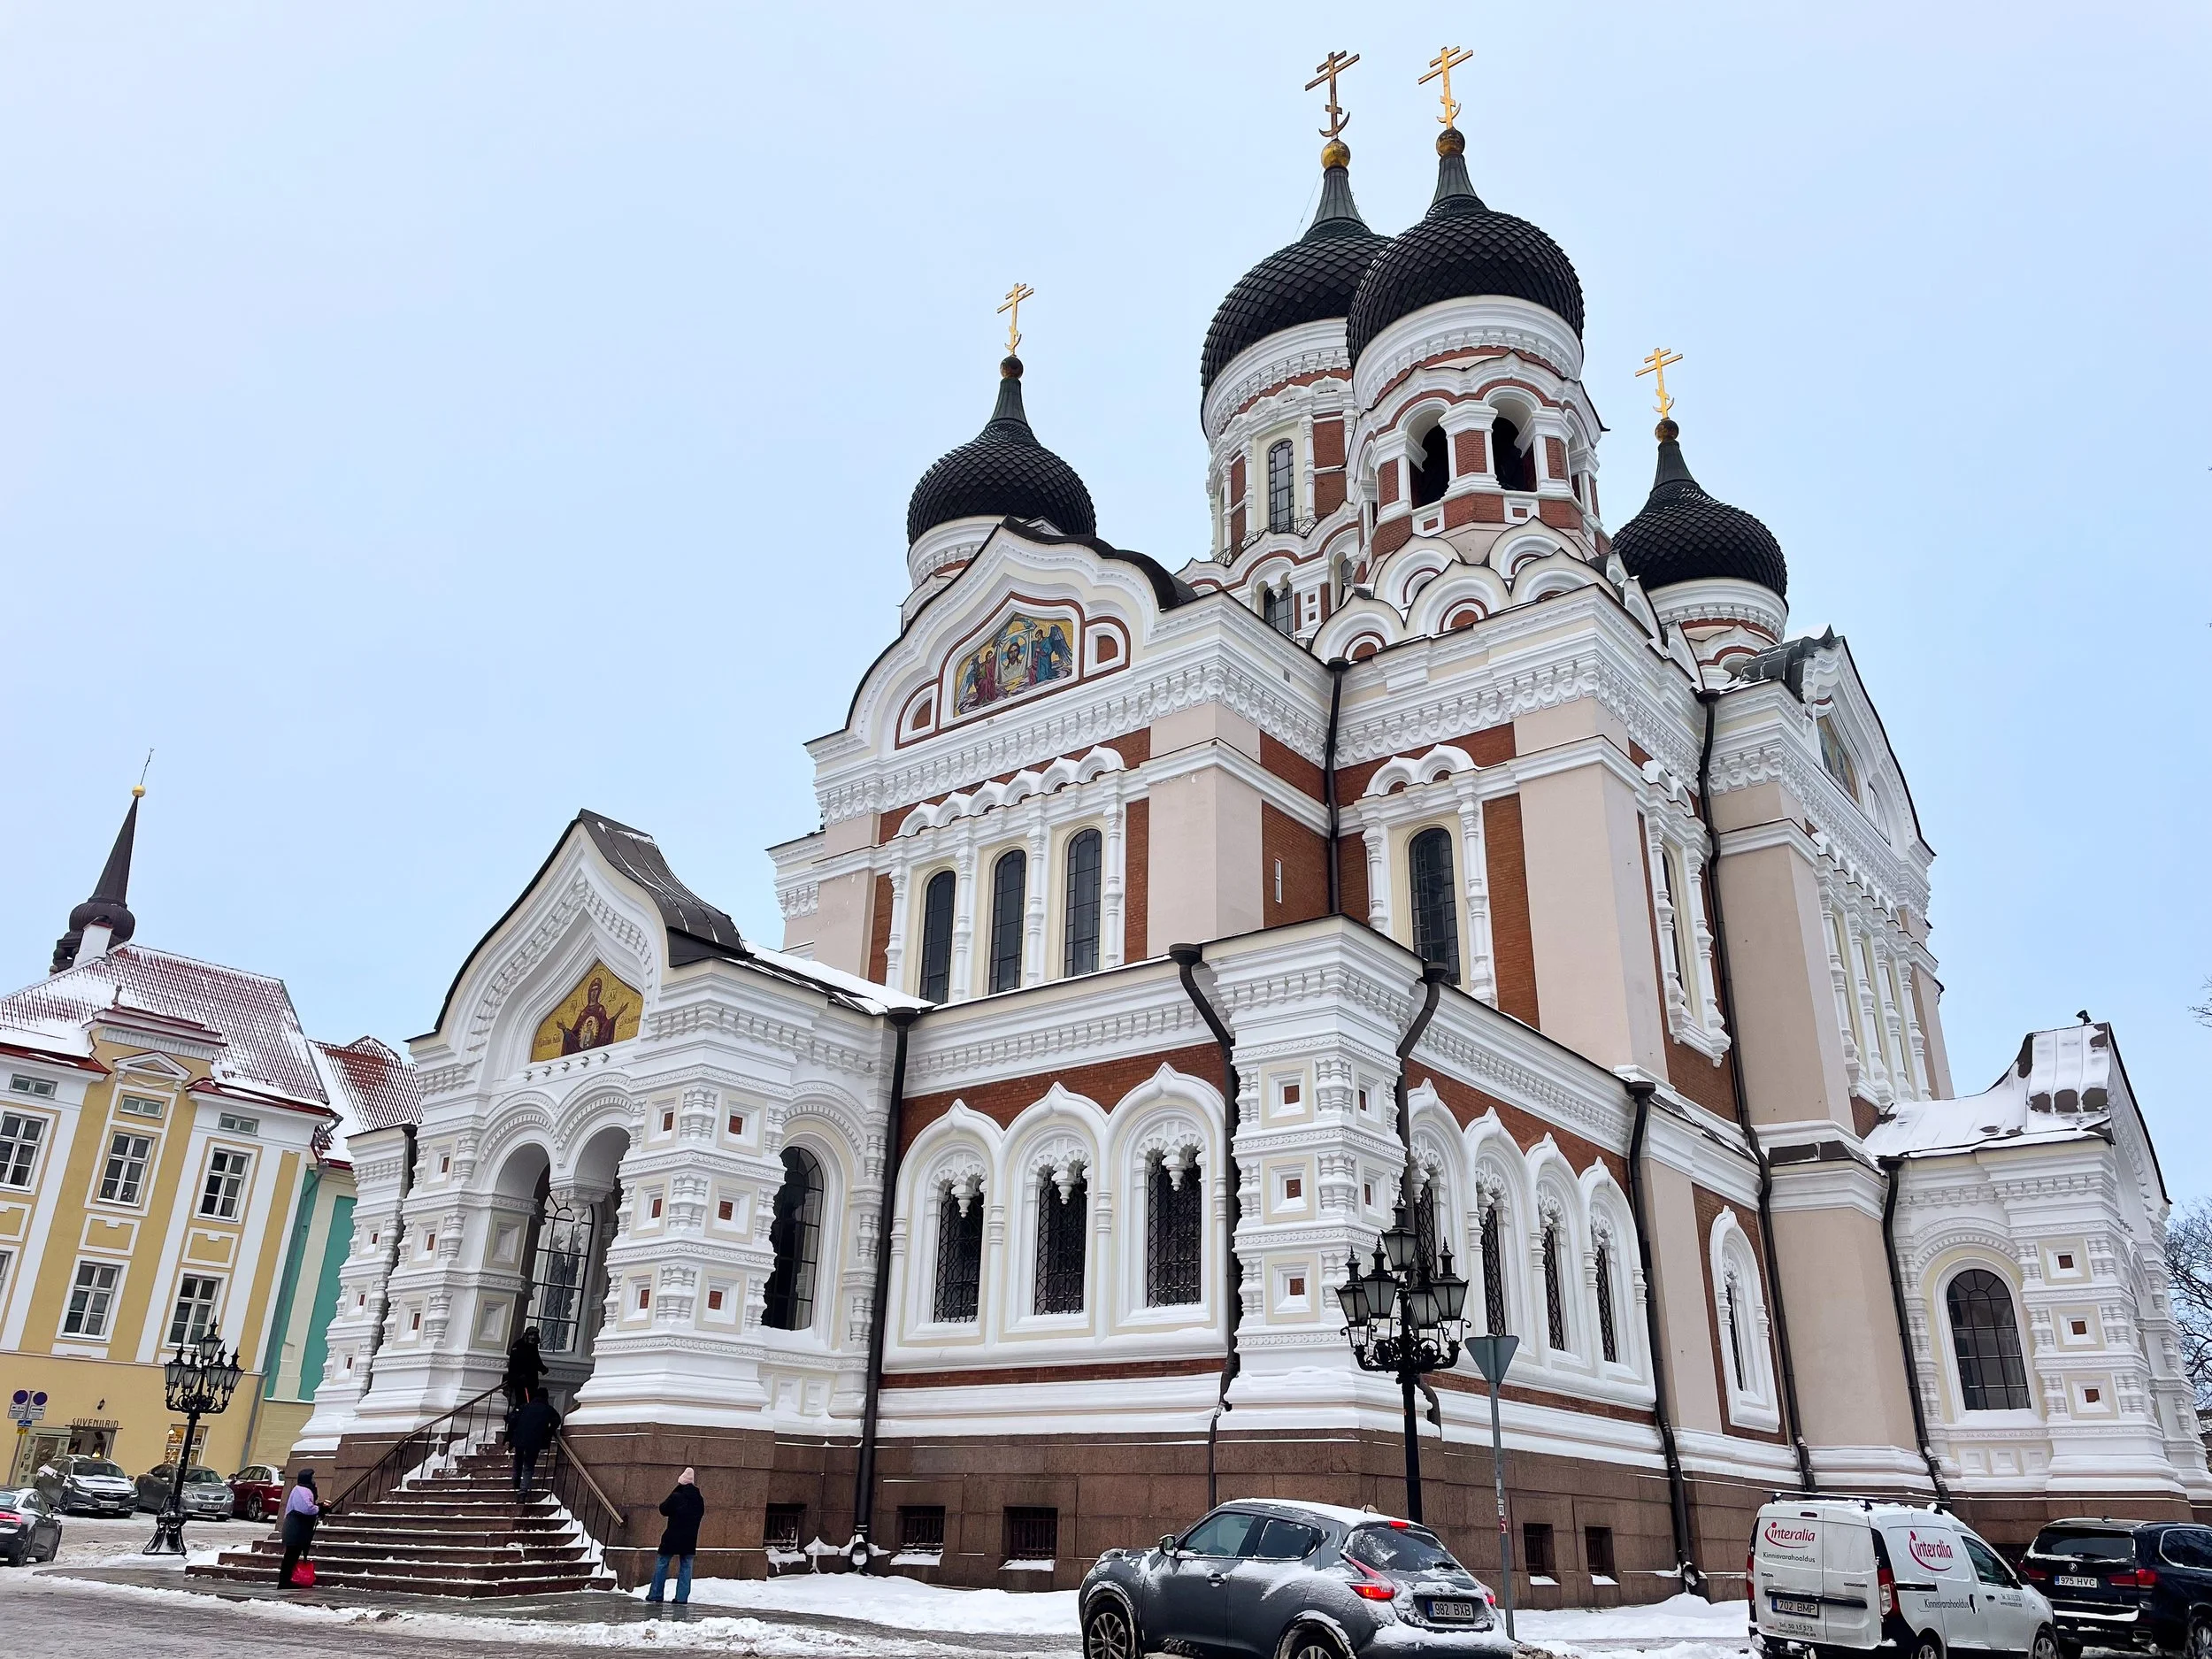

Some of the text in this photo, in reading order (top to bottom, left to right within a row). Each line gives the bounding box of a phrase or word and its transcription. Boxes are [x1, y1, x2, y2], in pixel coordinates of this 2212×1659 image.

[72, 1417, 119, 1428] SUVENIIRID
[1770, 1522, 1816, 1542] interalia
[1910, 1531, 1953, 1559] interalia
[1763, 1551, 1816, 1563] Kinnisvarahooldus
[2077, 1578, 2095, 1586] HVC
[1779, 1600, 1816, 1613] 702 BMP
[1924, 1598, 1970, 1609] Kinnisvarahooldus
[1434, 1603, 1471, 1617] 982 BXB
